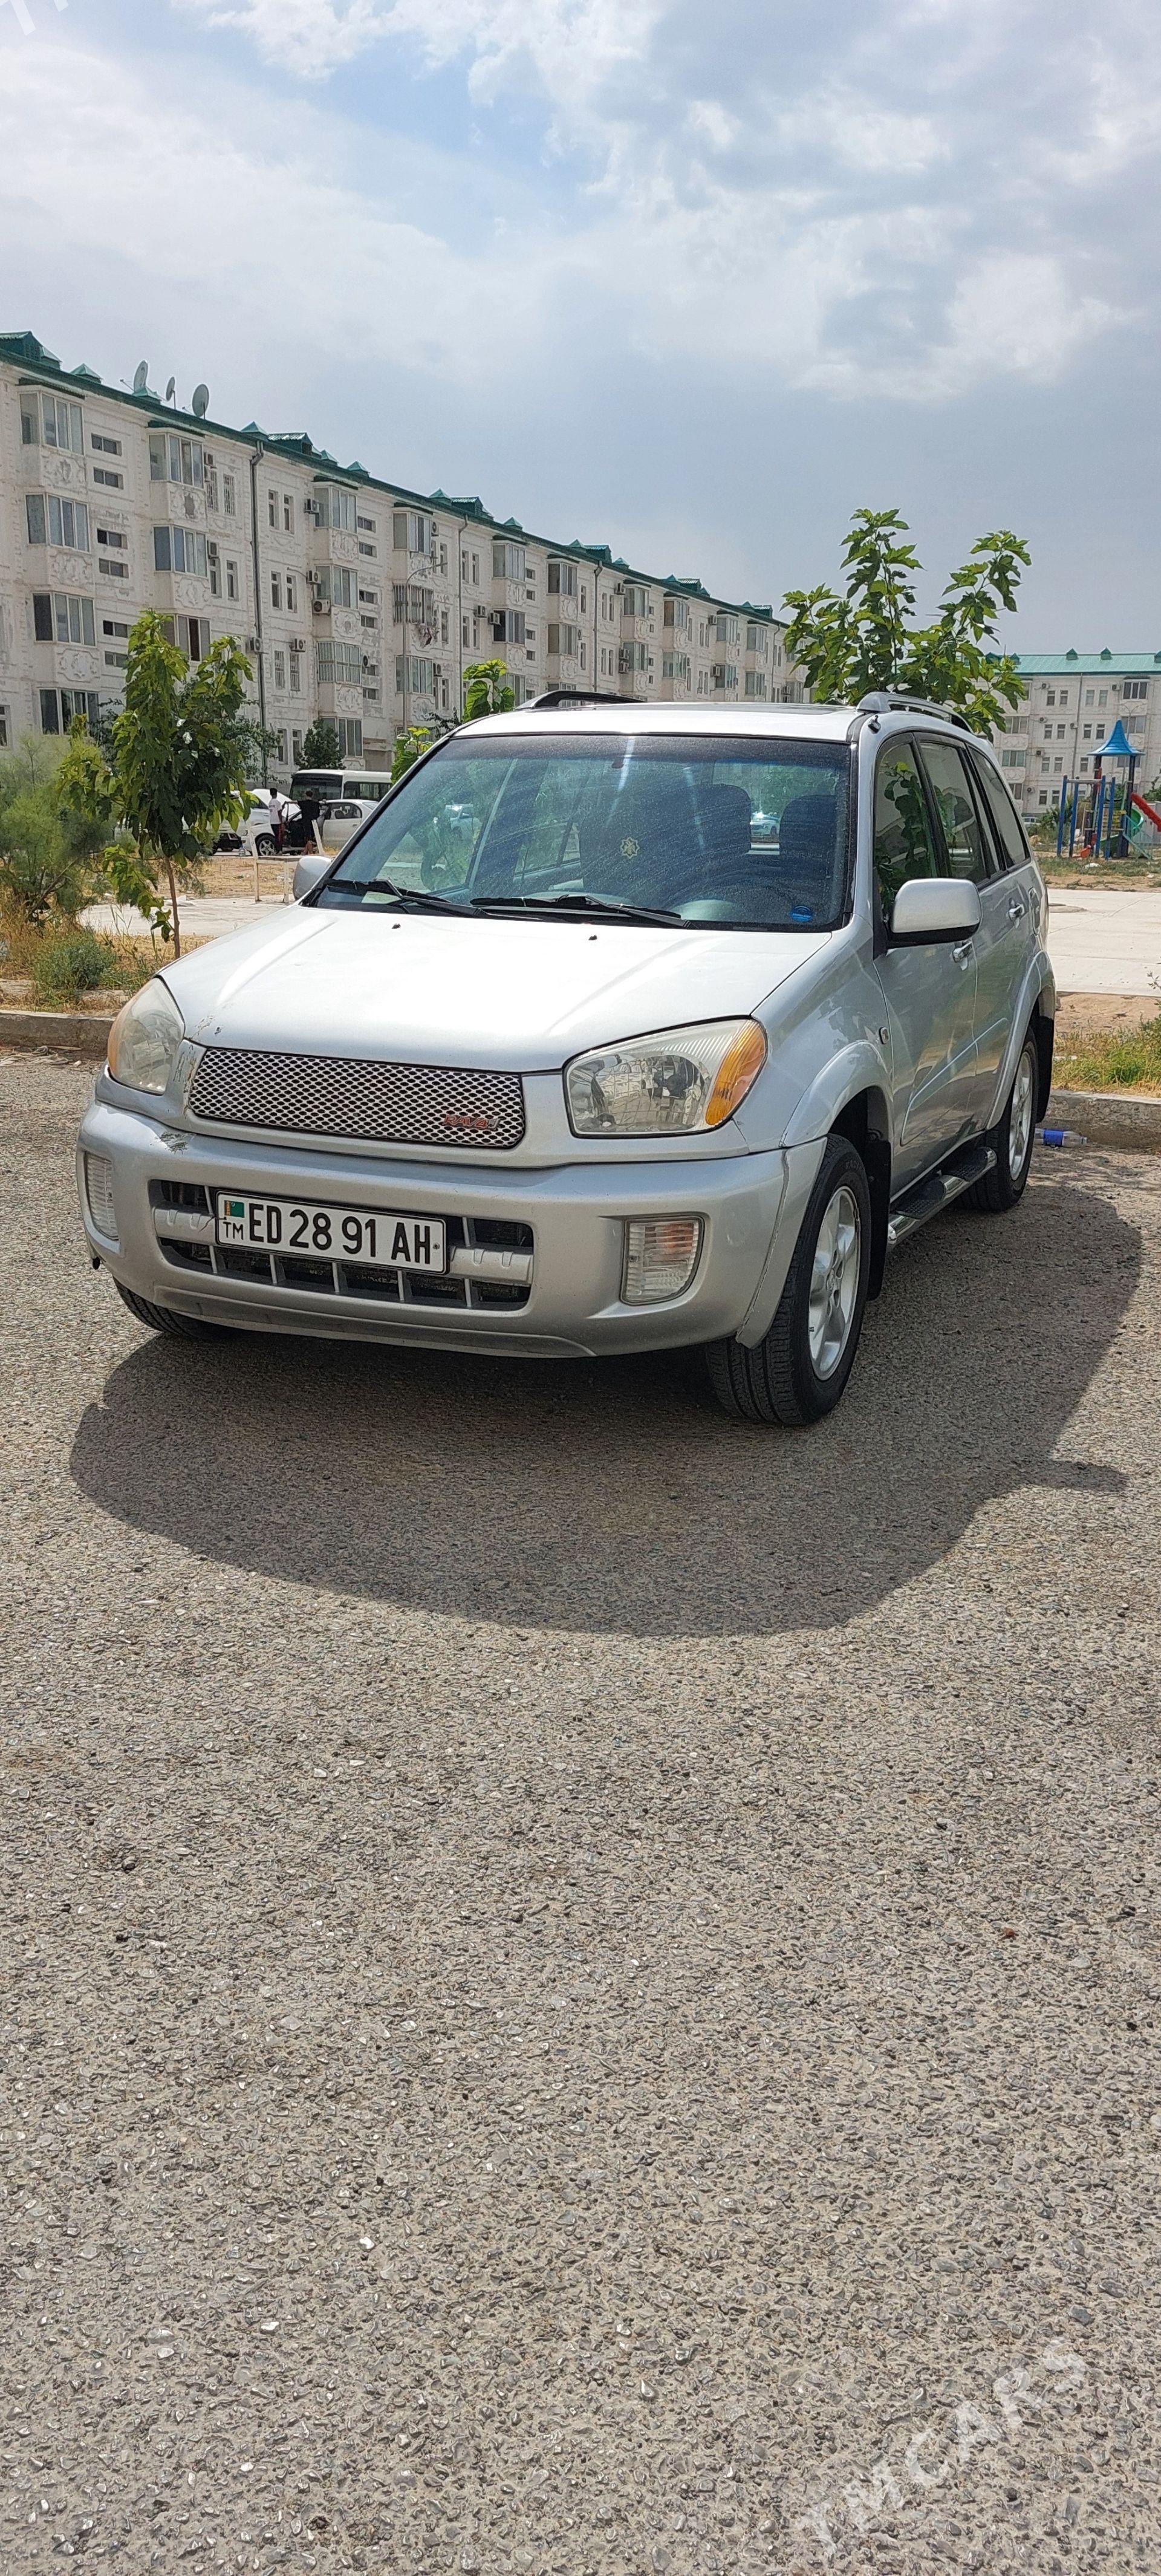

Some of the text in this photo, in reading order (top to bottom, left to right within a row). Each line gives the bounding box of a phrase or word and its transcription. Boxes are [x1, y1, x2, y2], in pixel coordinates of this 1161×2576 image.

[223, 1221, 244, 1240] TM
[249, 1202, 431, 1265] ED 28 91 AH
